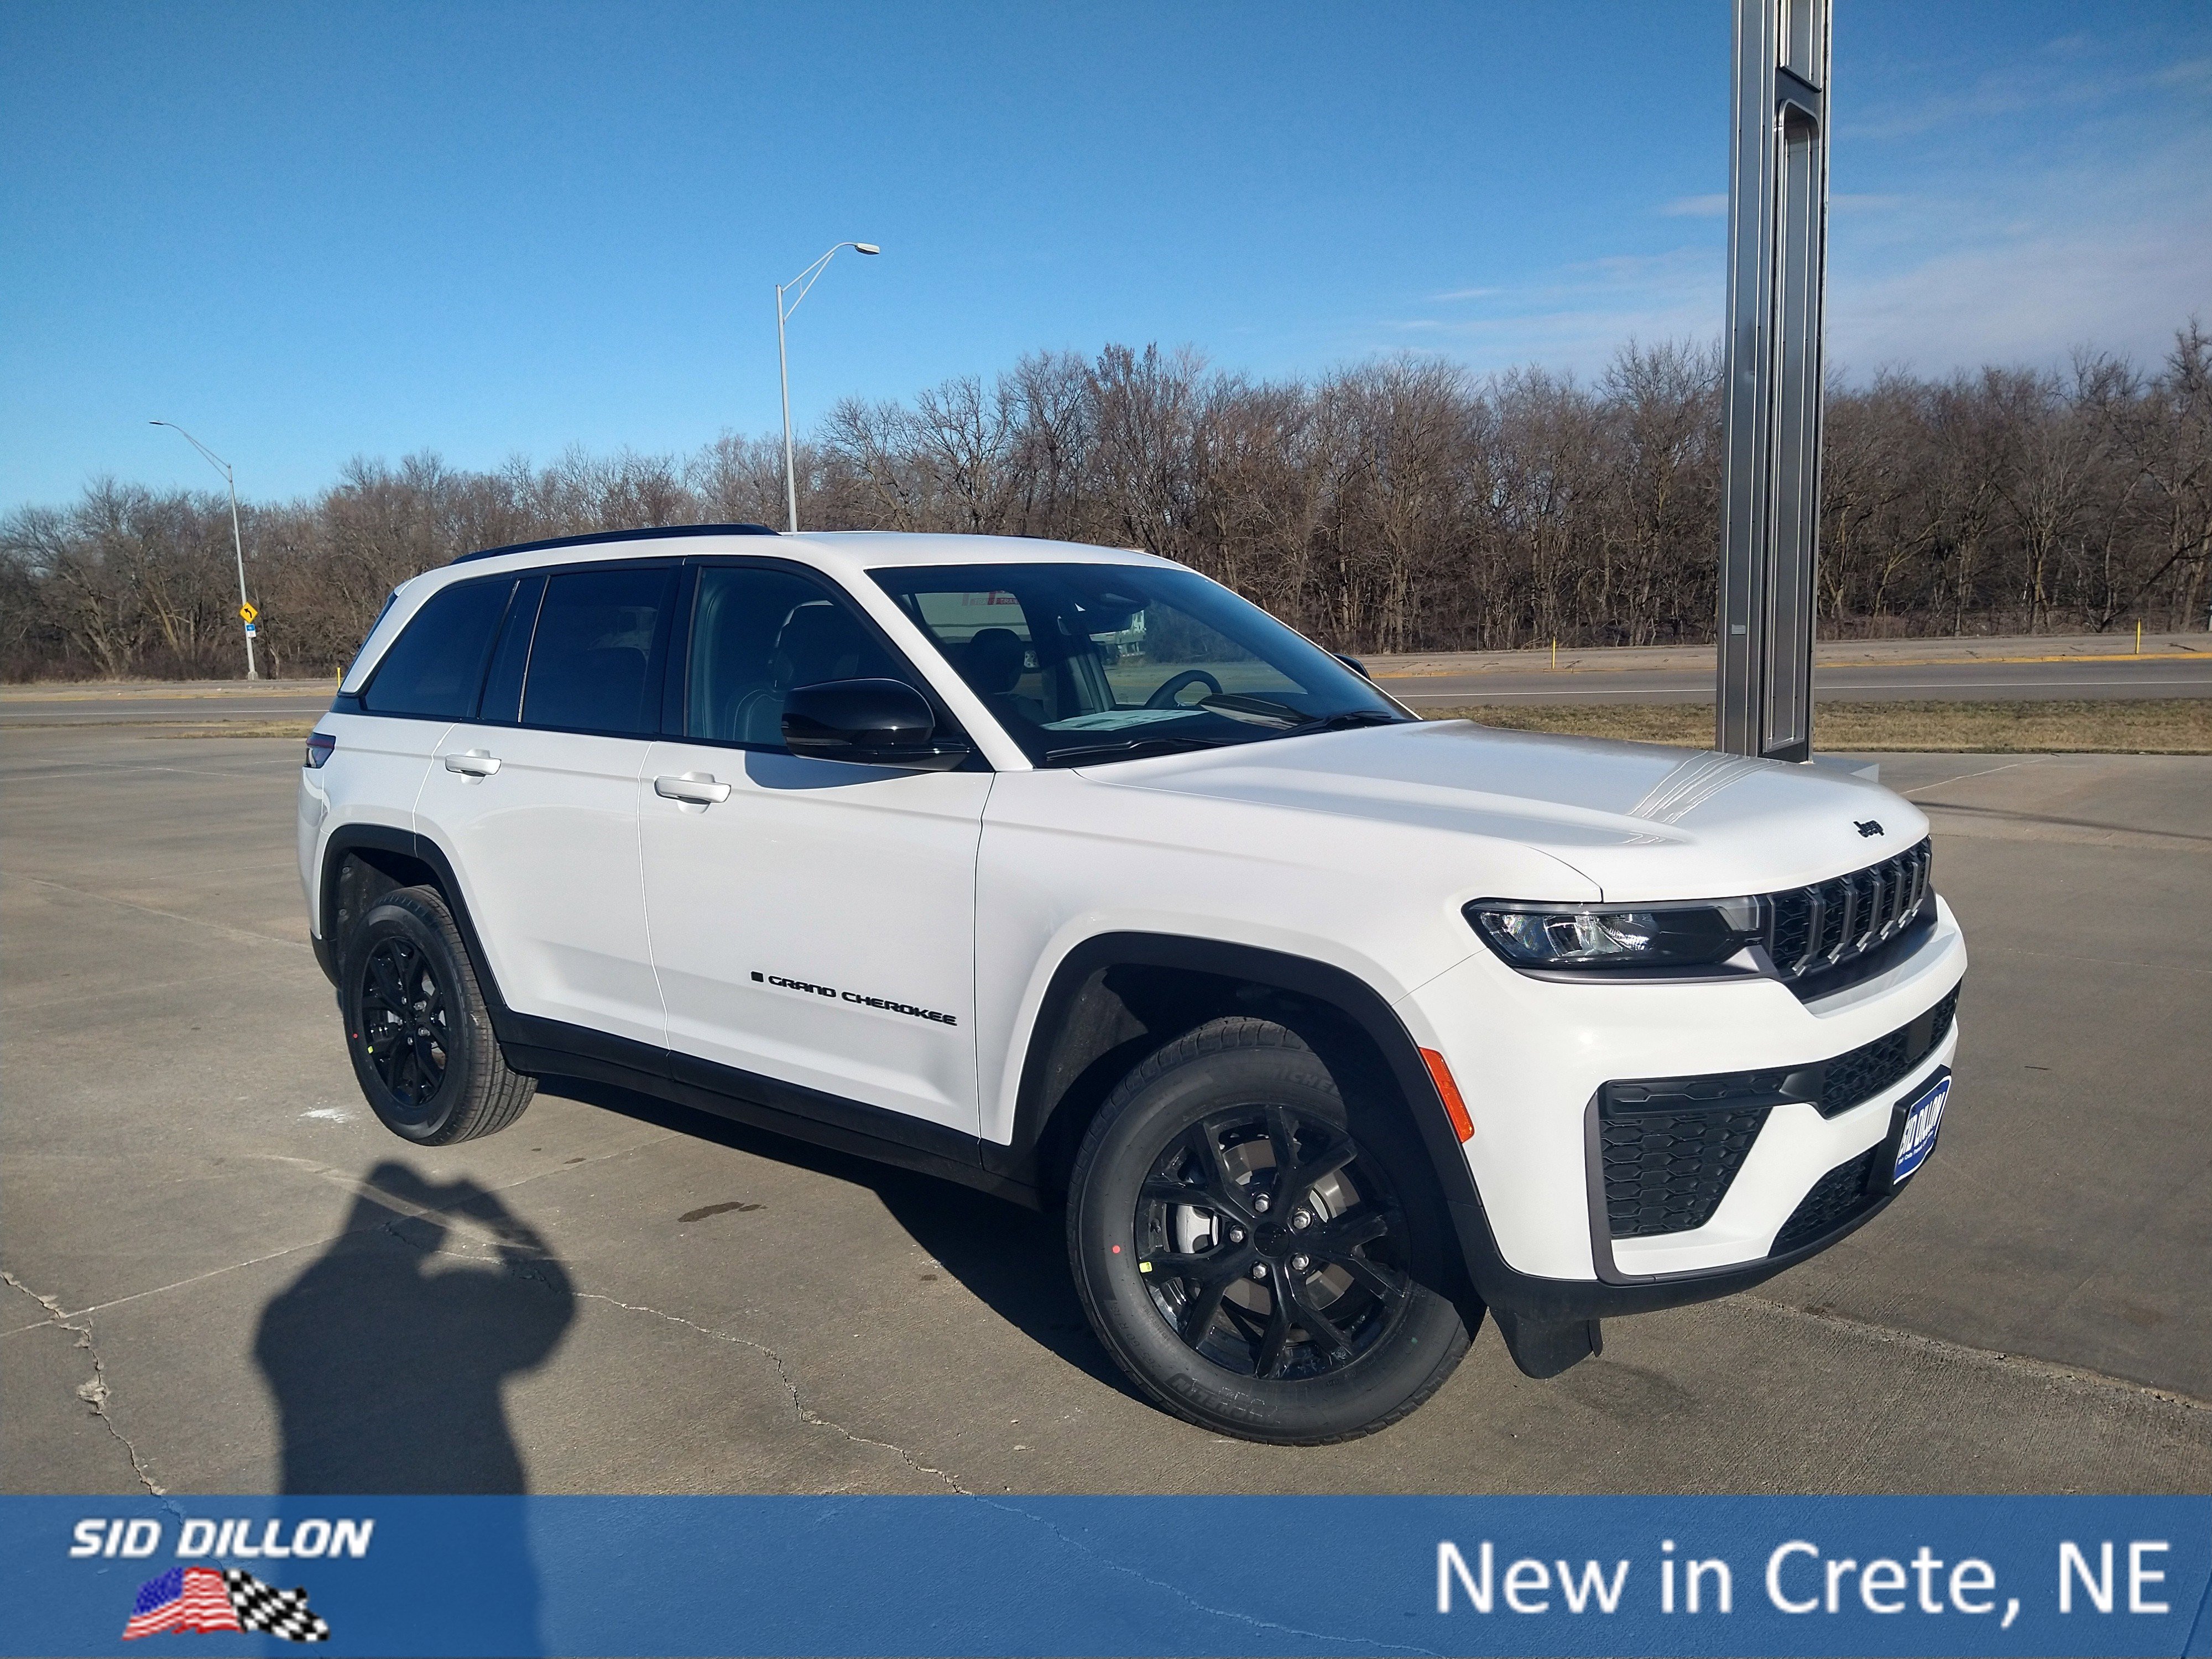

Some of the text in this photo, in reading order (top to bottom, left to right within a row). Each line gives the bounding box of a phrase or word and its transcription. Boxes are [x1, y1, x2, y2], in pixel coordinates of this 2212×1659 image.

[768, 975, 958, 1026] GRAND CHEROKEE
[1914, 1091, 1946, 1147] DILLON
